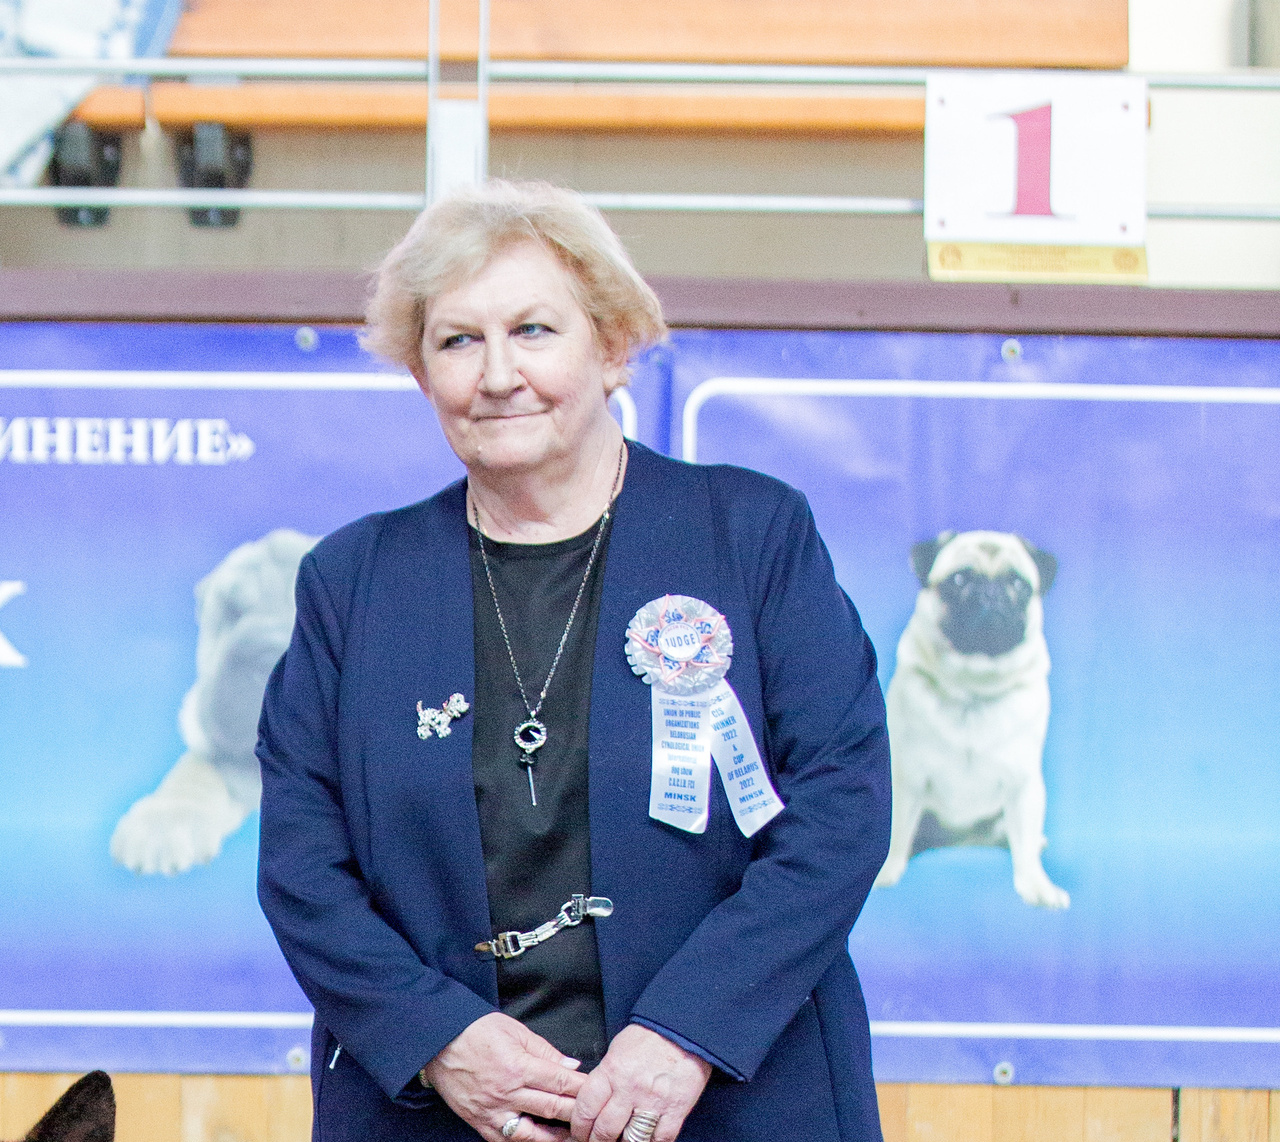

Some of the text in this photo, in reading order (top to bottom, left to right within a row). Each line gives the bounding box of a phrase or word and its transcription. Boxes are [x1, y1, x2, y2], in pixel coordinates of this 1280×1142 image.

[990, 102, 1070, 219] 1
[664, 791, 697, 802] MINSK
[739, 789, 764, 803] MINSK
